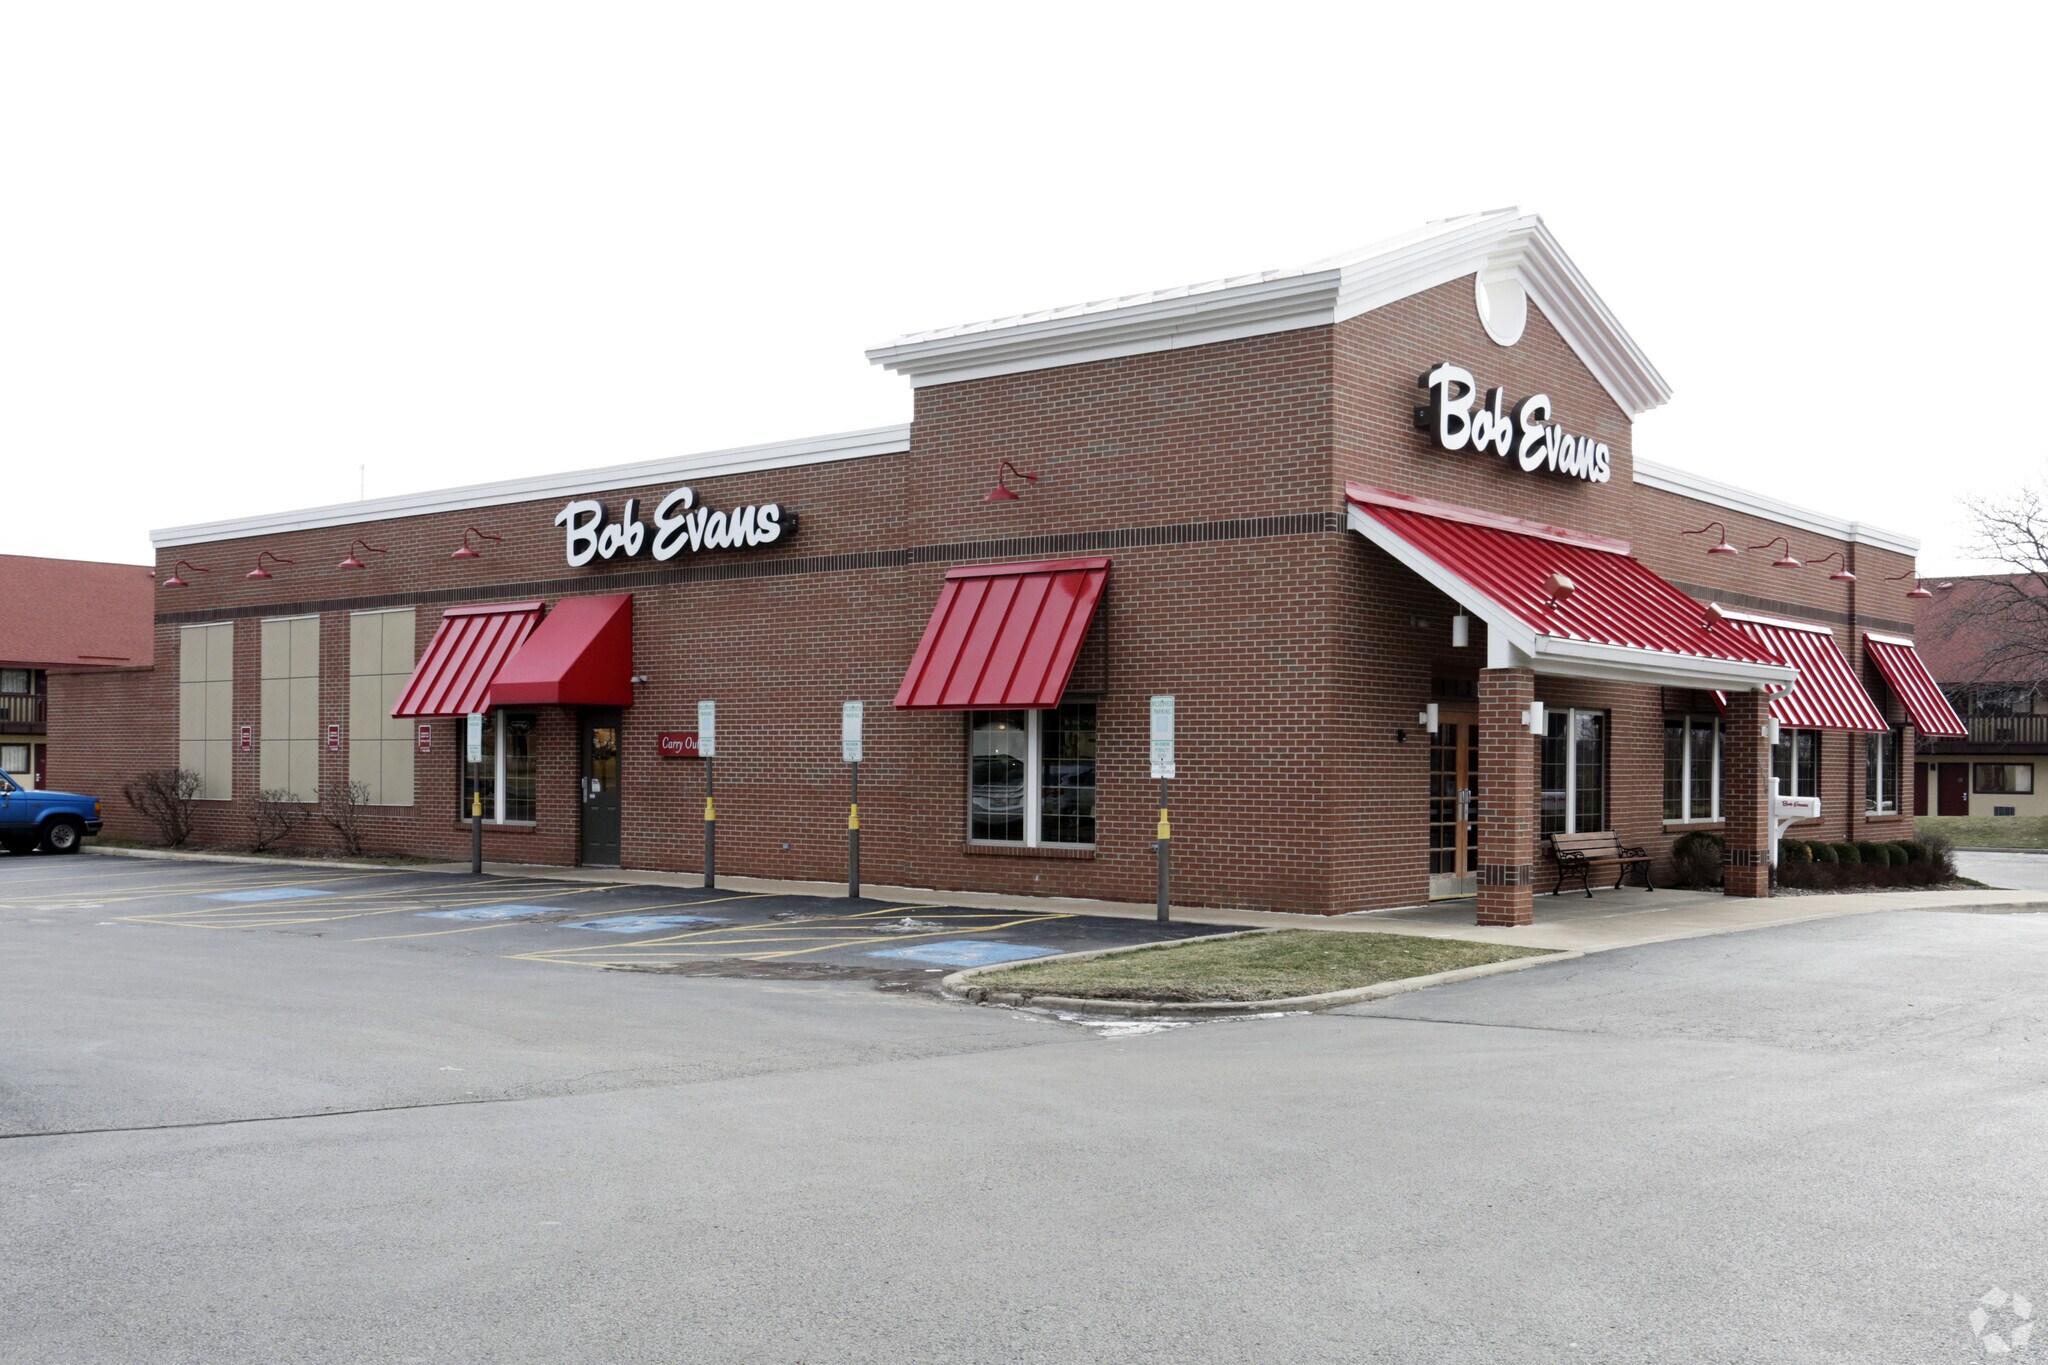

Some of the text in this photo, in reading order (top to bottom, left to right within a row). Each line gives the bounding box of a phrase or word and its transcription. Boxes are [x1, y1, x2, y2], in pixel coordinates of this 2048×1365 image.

[1428, 362, 1611, 483] Bob Evans
[554, 487, 781, 567] Bob Evans
[662, 736, 684, 754] Carry
[685, 736, 699, 750] Ou
